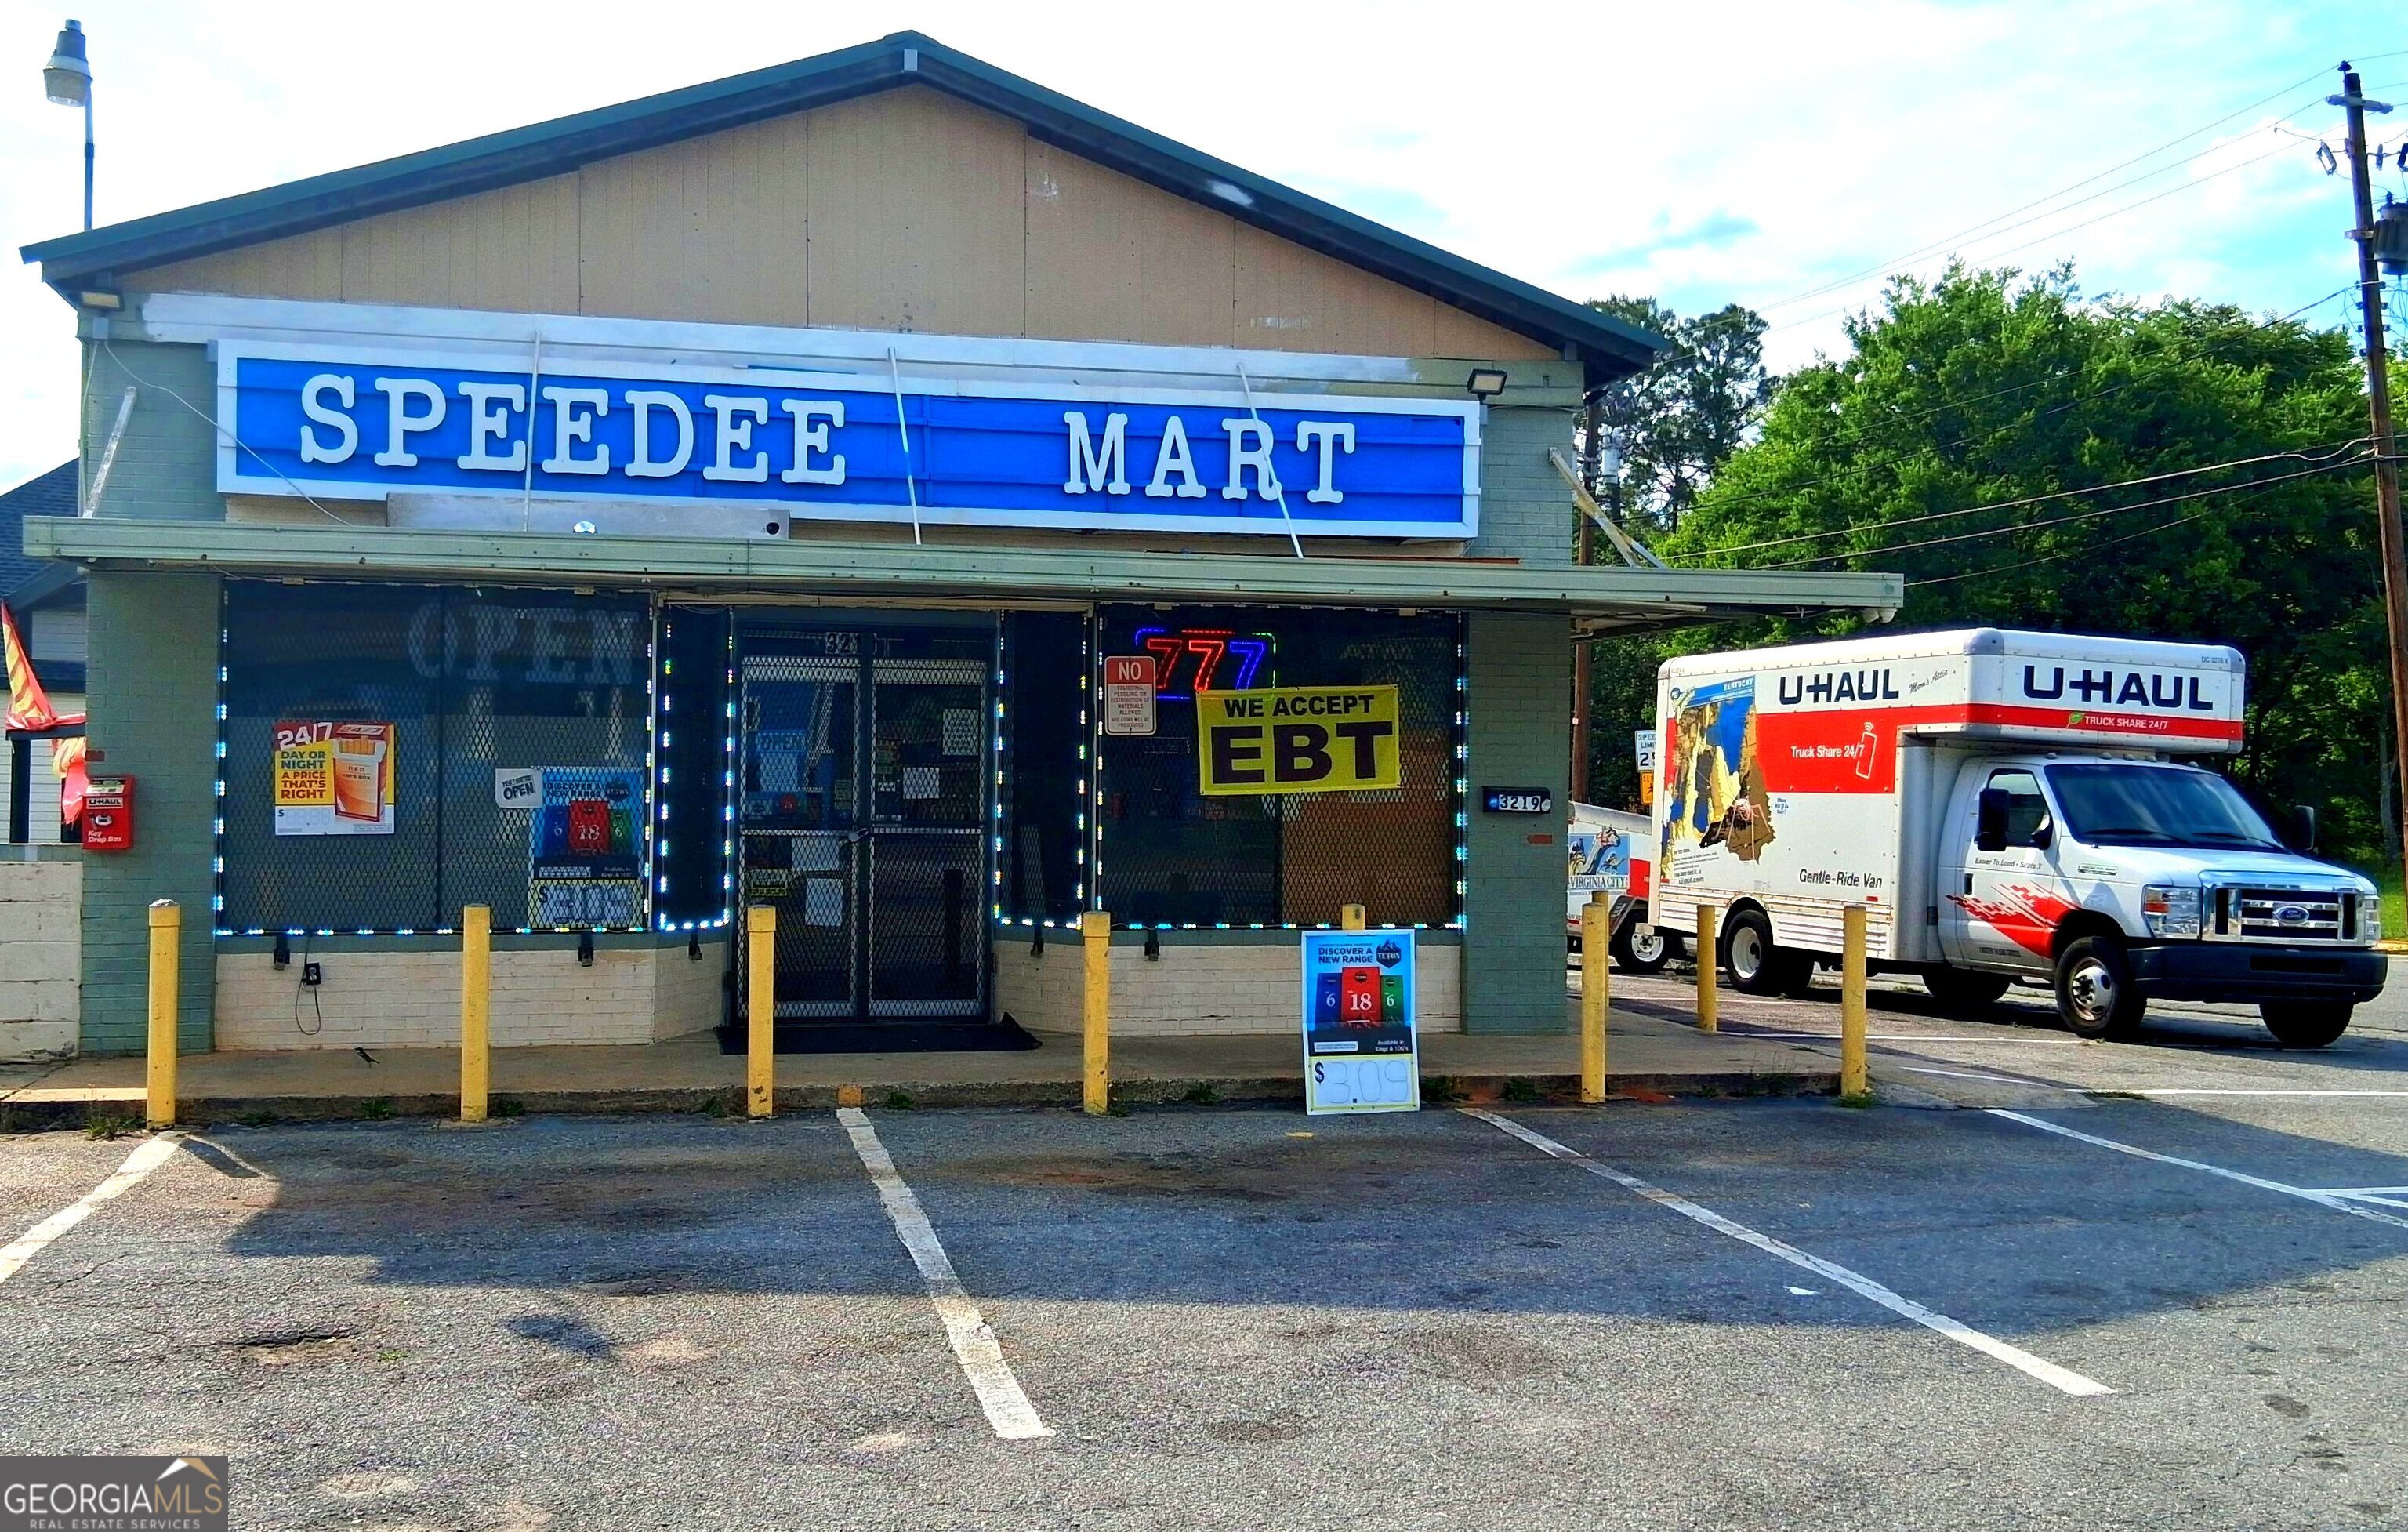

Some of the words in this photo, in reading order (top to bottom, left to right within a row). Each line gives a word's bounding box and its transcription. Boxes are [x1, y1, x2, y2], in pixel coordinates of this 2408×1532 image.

[299, 374, 846, 485] SPEEDEE
[1062, 410, 1355, 503] MART
[408, 602, 639, 683] OPEN
[1119, 662, 1141, 681] NO
[1147, 637, 1265, 691] 777
[1779, 668, 1899, 705] U-HAUL
[2024, 665, 2213, 710] U-HAUL
[1224, 697, 1264, 717] WE
[1272, 695, 1375, 716] ACCEPT
[2085, 715, 2114, 726] TRUCK
[2116, 718, 2147, 728] SHARE
[2148, 720, 2169, 730] 24/7
[277, 722, 333, 751] 24/7
[281, 750, 303, 759] DAY
[1210, 721, 1393, 784] EBT
[1791, 745, 1815, 758] Truck
[1816, 745, 1842, 758] Share
[1844, 744, 1865, 759] 24/7
[281, 761, 326, 769] NIGHT
[281, 790, 326, 799] RIGHT
[503, 782, 535, 800] OPEN
[1500, 795, 1539, 811] 3219
[1570, 876, 1606, 888] VIRGINIA
[1799, 869, 1859, 887] Gentle-Ride
[1864, 873, 1883, 889] Van
[1318, 947, 1364, 956] DISCOVER
[1366, 946, 1373, 955] A
[1318, 955, 1340, 964] NEW
[1342, 955, 1373, 964] RANGE
[1326, 993, 1336, 1007] 6
[1350, 993, 1373, 1011] 18
[1386, 993, 1395, 1007] 6
